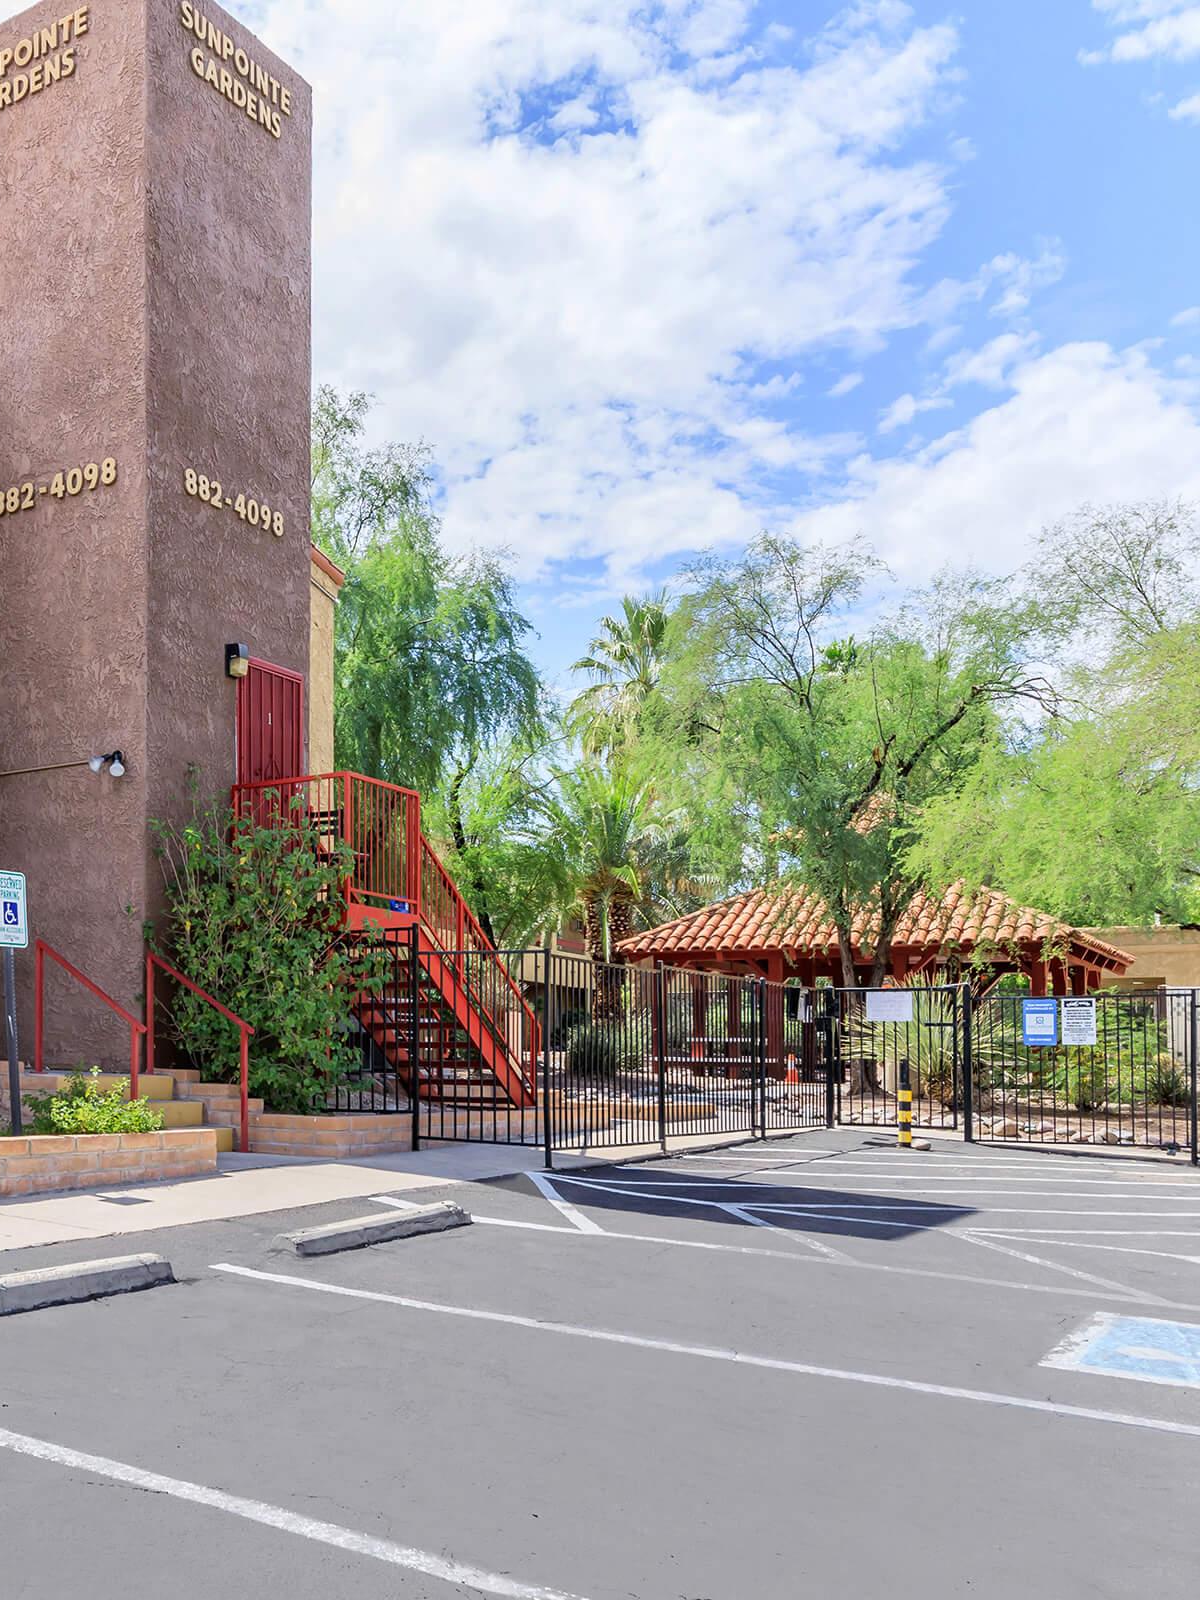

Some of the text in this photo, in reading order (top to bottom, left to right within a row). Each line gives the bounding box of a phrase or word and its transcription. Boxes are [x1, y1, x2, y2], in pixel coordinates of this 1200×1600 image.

[181, 0, 291, 116] SUNPOINTE
[190, 47, 281, 138] GARDENS
[184, 468, 284, 537] 882-4098
